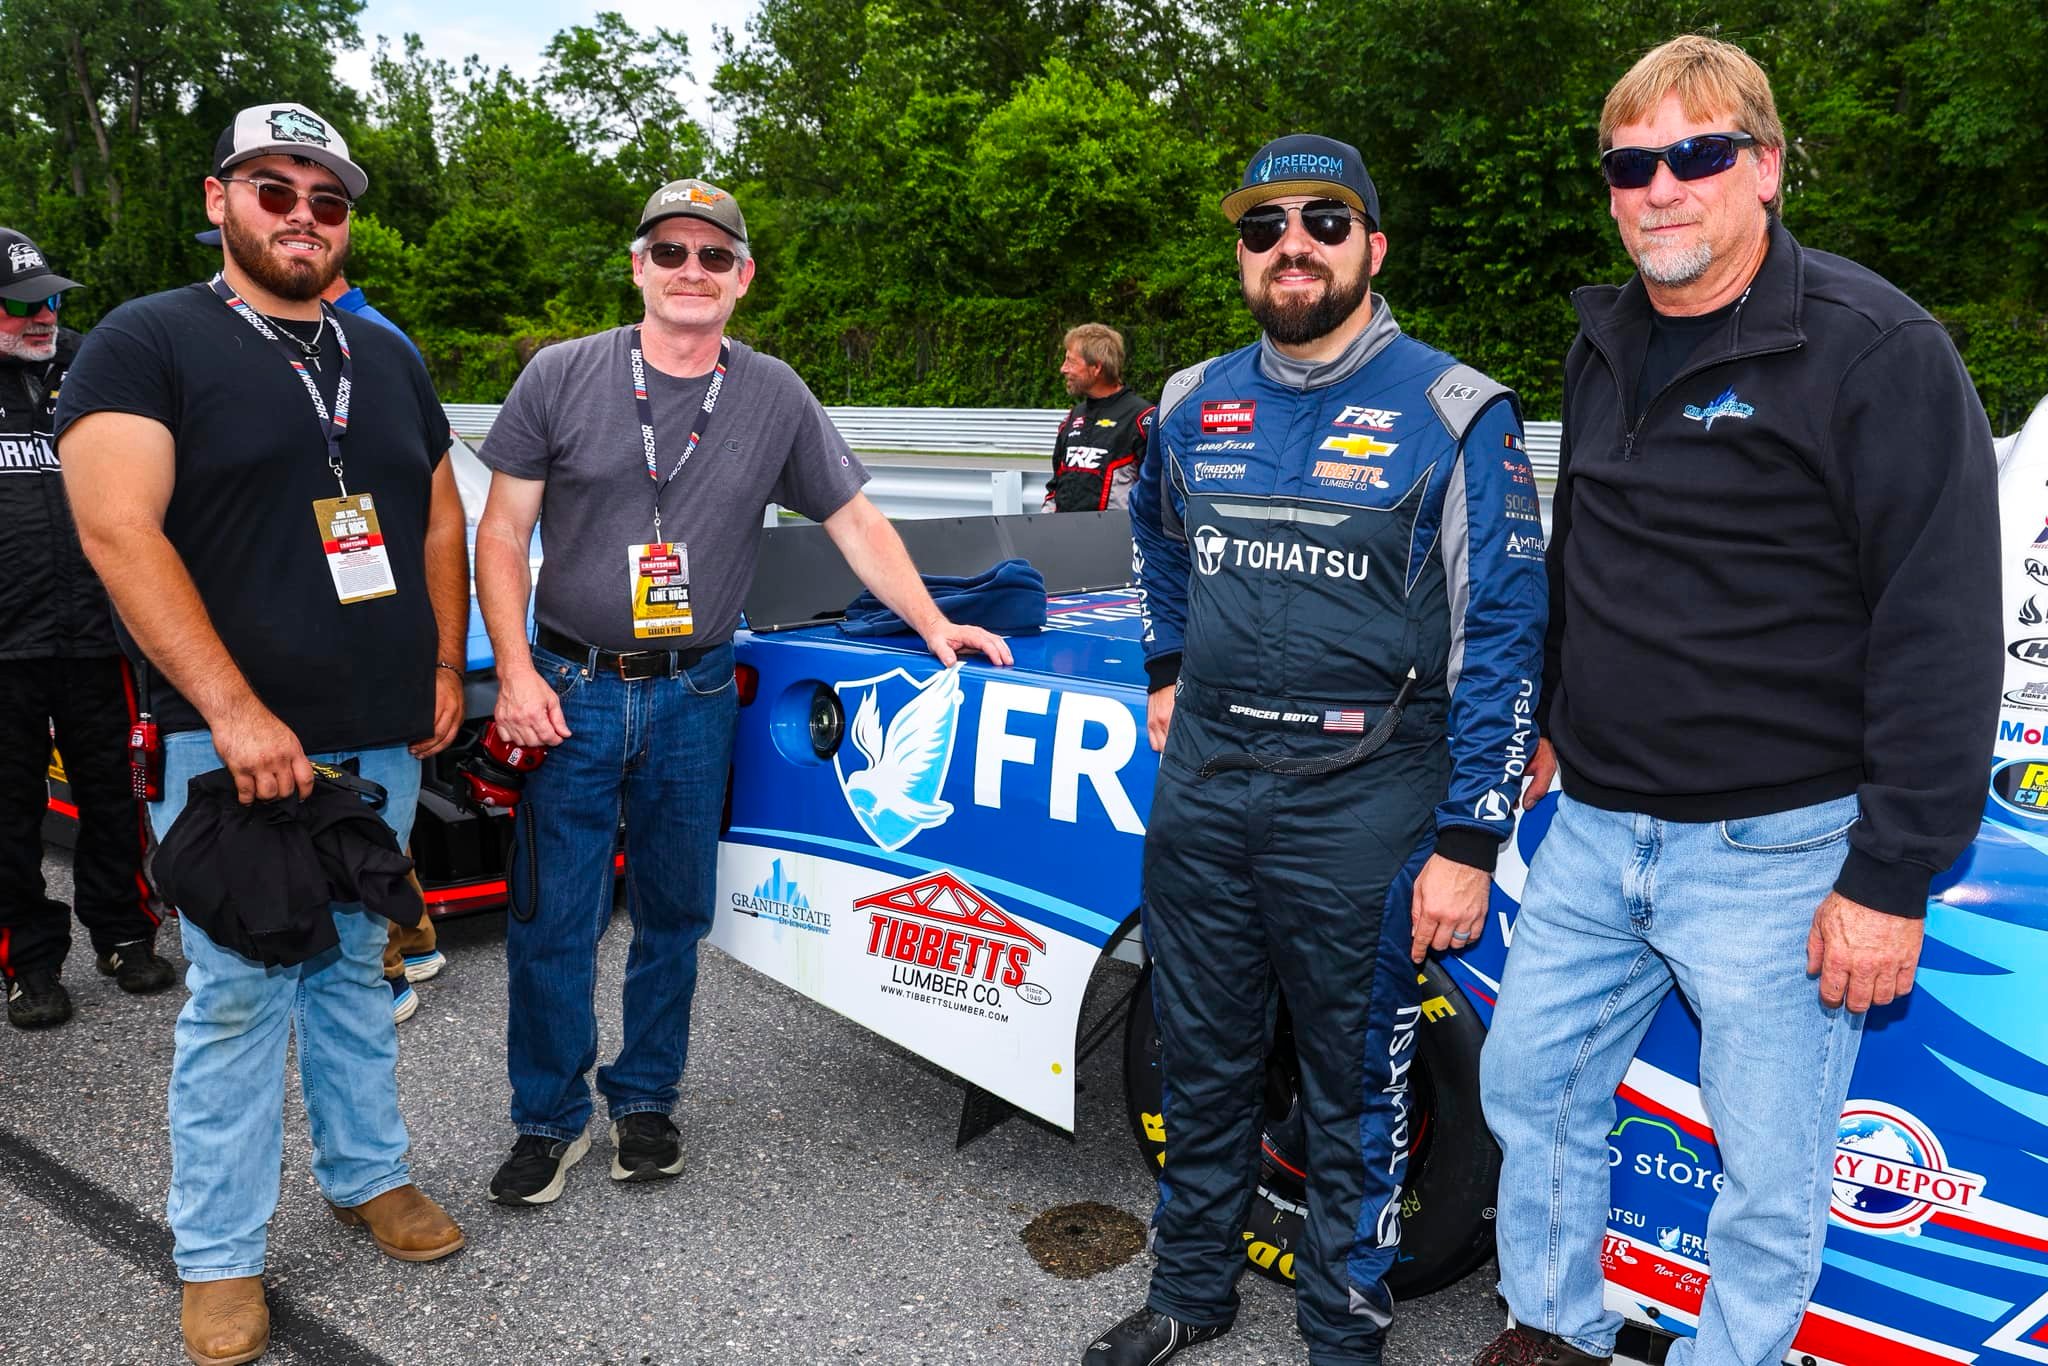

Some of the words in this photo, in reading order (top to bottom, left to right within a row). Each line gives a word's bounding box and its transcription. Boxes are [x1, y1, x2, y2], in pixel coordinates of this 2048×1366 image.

[1274, 153, 1343, 171] FREEDOM
[1274, 165, 1343, 179] WARRANTY
[660, 186, 714, 207] FedEx
[240, 306, 279, 341] NASCAR
[631, 349, 647, 387] NASCAR
[300, 373, 330, 420] NASCAR
[334, 375, 352, 416] NASCAR
[701, 373, 723, 414] NASCAR
[1203, 412, 1252, 423] CRAFTSMAN
[1334, 405, 1403, 429] FRE
[0, 438, 60, 467] RKIN
[641, 424, 657, 467] NASCAR
[1066, 446, 1108, 469] FRE
[1195, 440, 1256, 452] GOODYEAR
[1204, 463, 1247, 475] FREEDOM
[1312, 461, 1384, 485] TIBBETTS
[1321, 478, 1354, 489] LUMBER
[1233, 540, 1369, 581] TOHATSU
[650, 590, 667, 603] LIME
[668, 588, 689, 601] ROCK
[1229, 704, 1280, 720] SPENCER
[1282, 712, 1319, 723] BOYD
[974, 680, 1147, 836] FR
[731, 892, 789, 918] GRANITE
[792, 906, 831, 928] STATE
[866, 912, 1031, 989] TIBBETTS
[892, 964, 968, 999] LUMBER
[973, 984, 1002, 1008] CO.
[1024, 985, 1043, 995] Since
[880, 984, 1009, 1023] WWW.TIBBETTSLUMBER.COM
[1634, 1152, 1724, 1193] store
[1874, 1162, 1977, 1206] DEPOT
[1653, 1263, 1703, 1286] Nor-Cal
